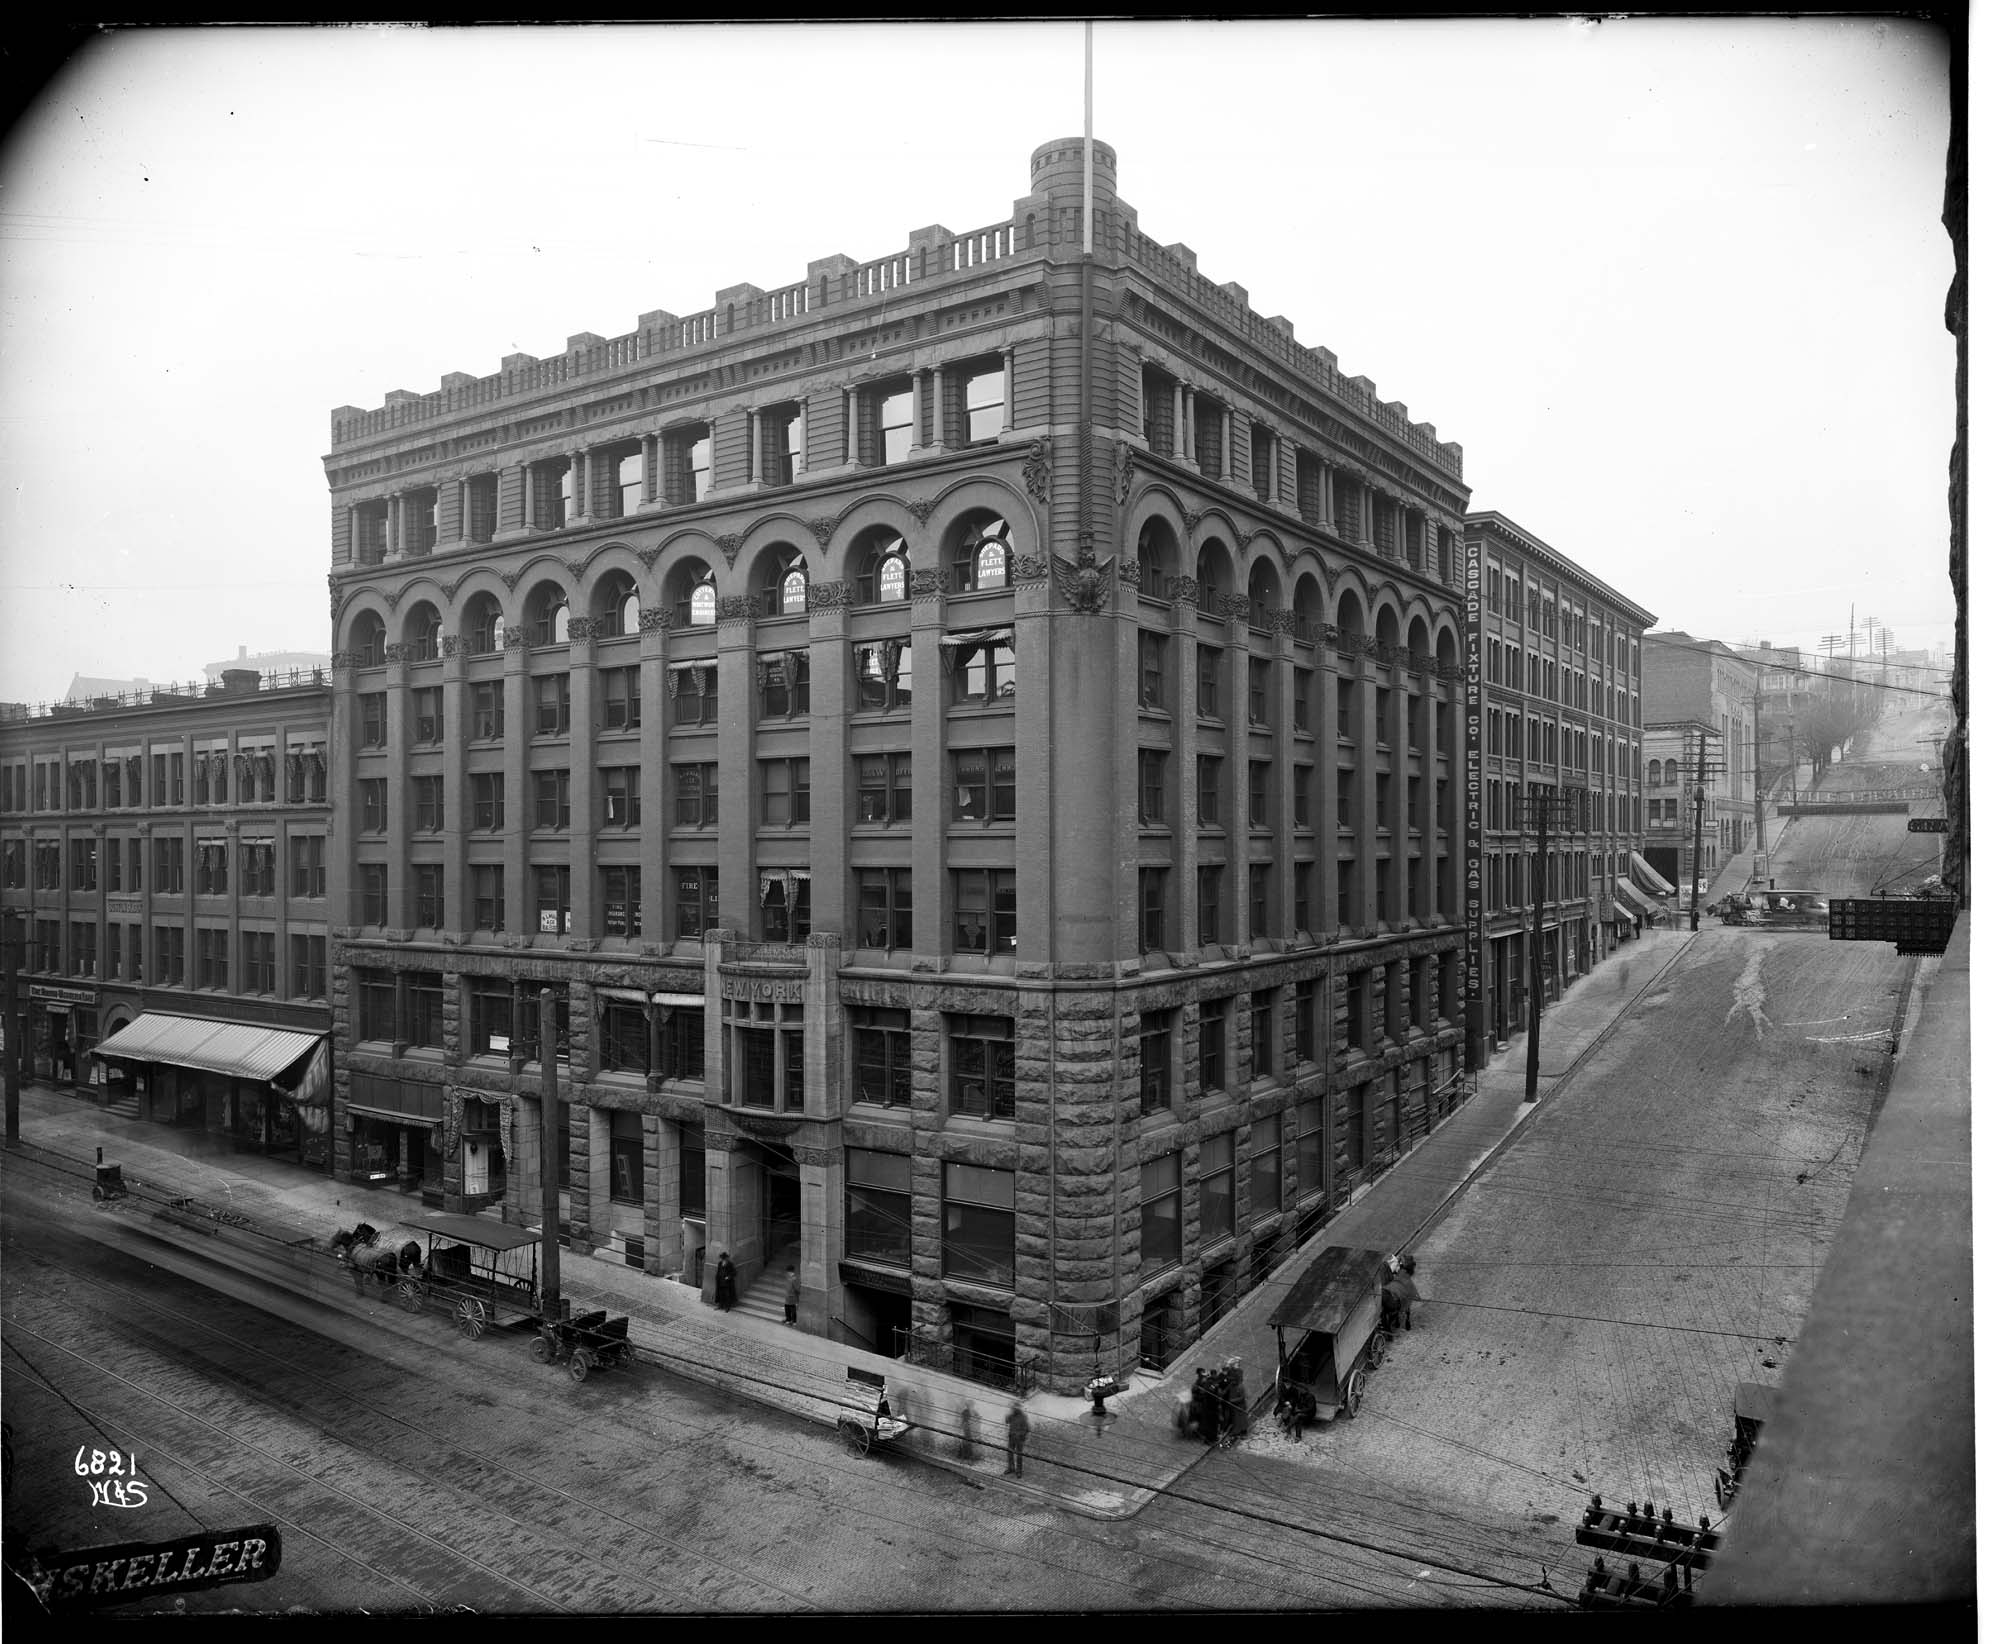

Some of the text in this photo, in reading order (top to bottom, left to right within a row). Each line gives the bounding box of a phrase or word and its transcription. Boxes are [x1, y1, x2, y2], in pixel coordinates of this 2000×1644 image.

[978, 567, 1005, 577] LAWYERS
[1467, 547, 1479, 622] CASCADE
[1468, 633, 1479, 705] FIXTURE
[1468, 715, 1479, 740] CO.
[1468, 751, 1480, 829] ELECTRIC
[1468, 840, 1480, 848] &
[1468, 859, 1480, 889] GAS
[721, 981, 803, 1000] NEW YORK
